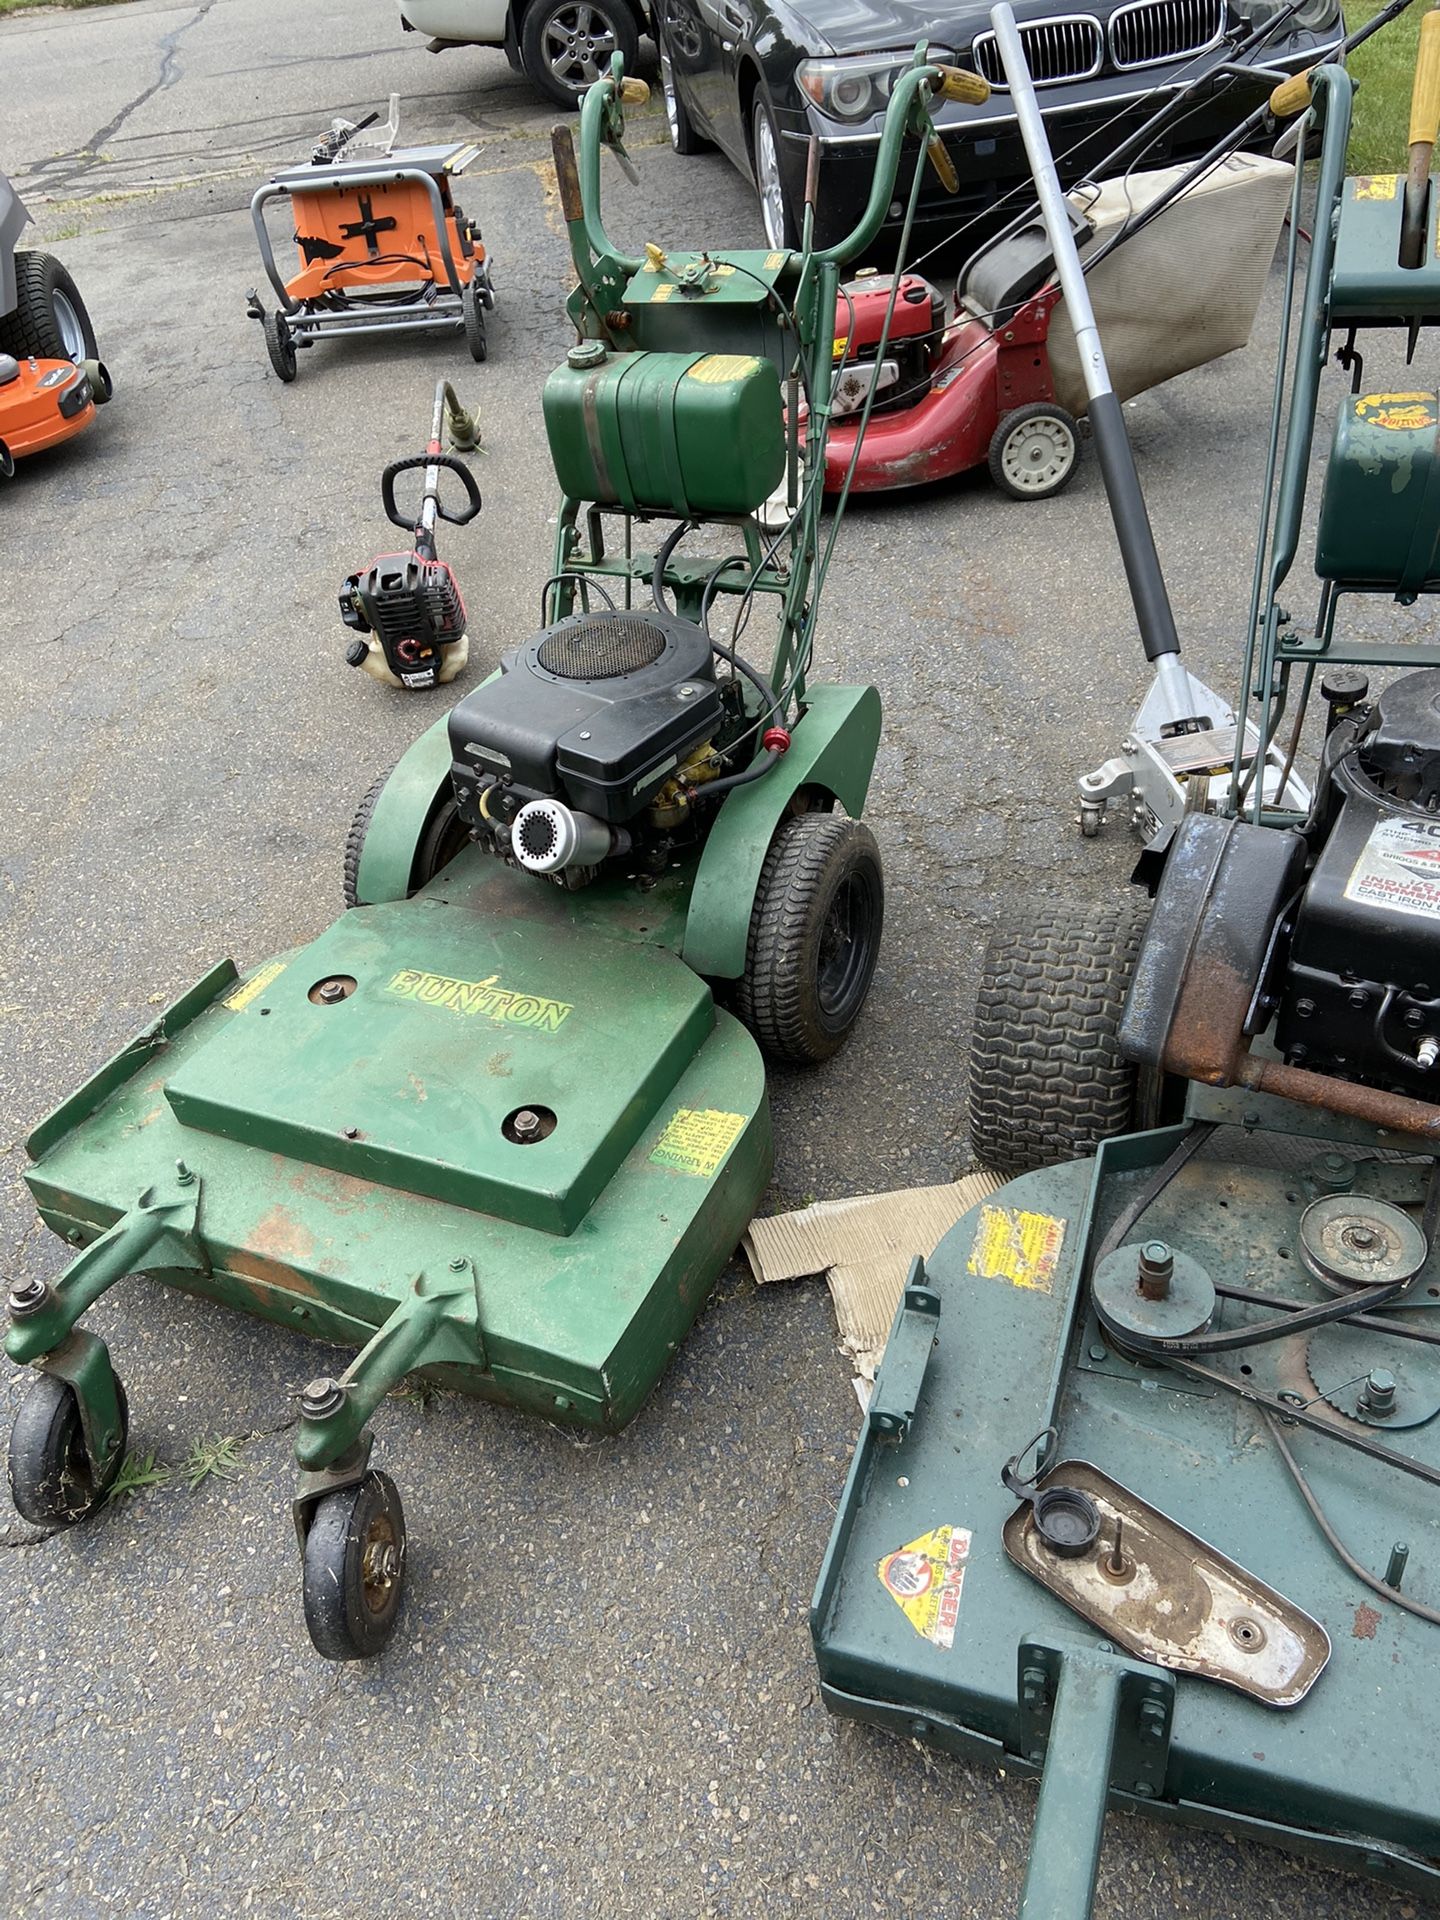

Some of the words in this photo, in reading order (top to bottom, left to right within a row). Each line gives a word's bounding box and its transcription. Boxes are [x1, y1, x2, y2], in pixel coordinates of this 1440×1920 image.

[1383, 852, 1418, 865] BRIGGS
[1358, 886, 1395, 899] CAST
[1398, 896, 1433, 908] IRON
[385, 969, 573, 1032] BUNTON
